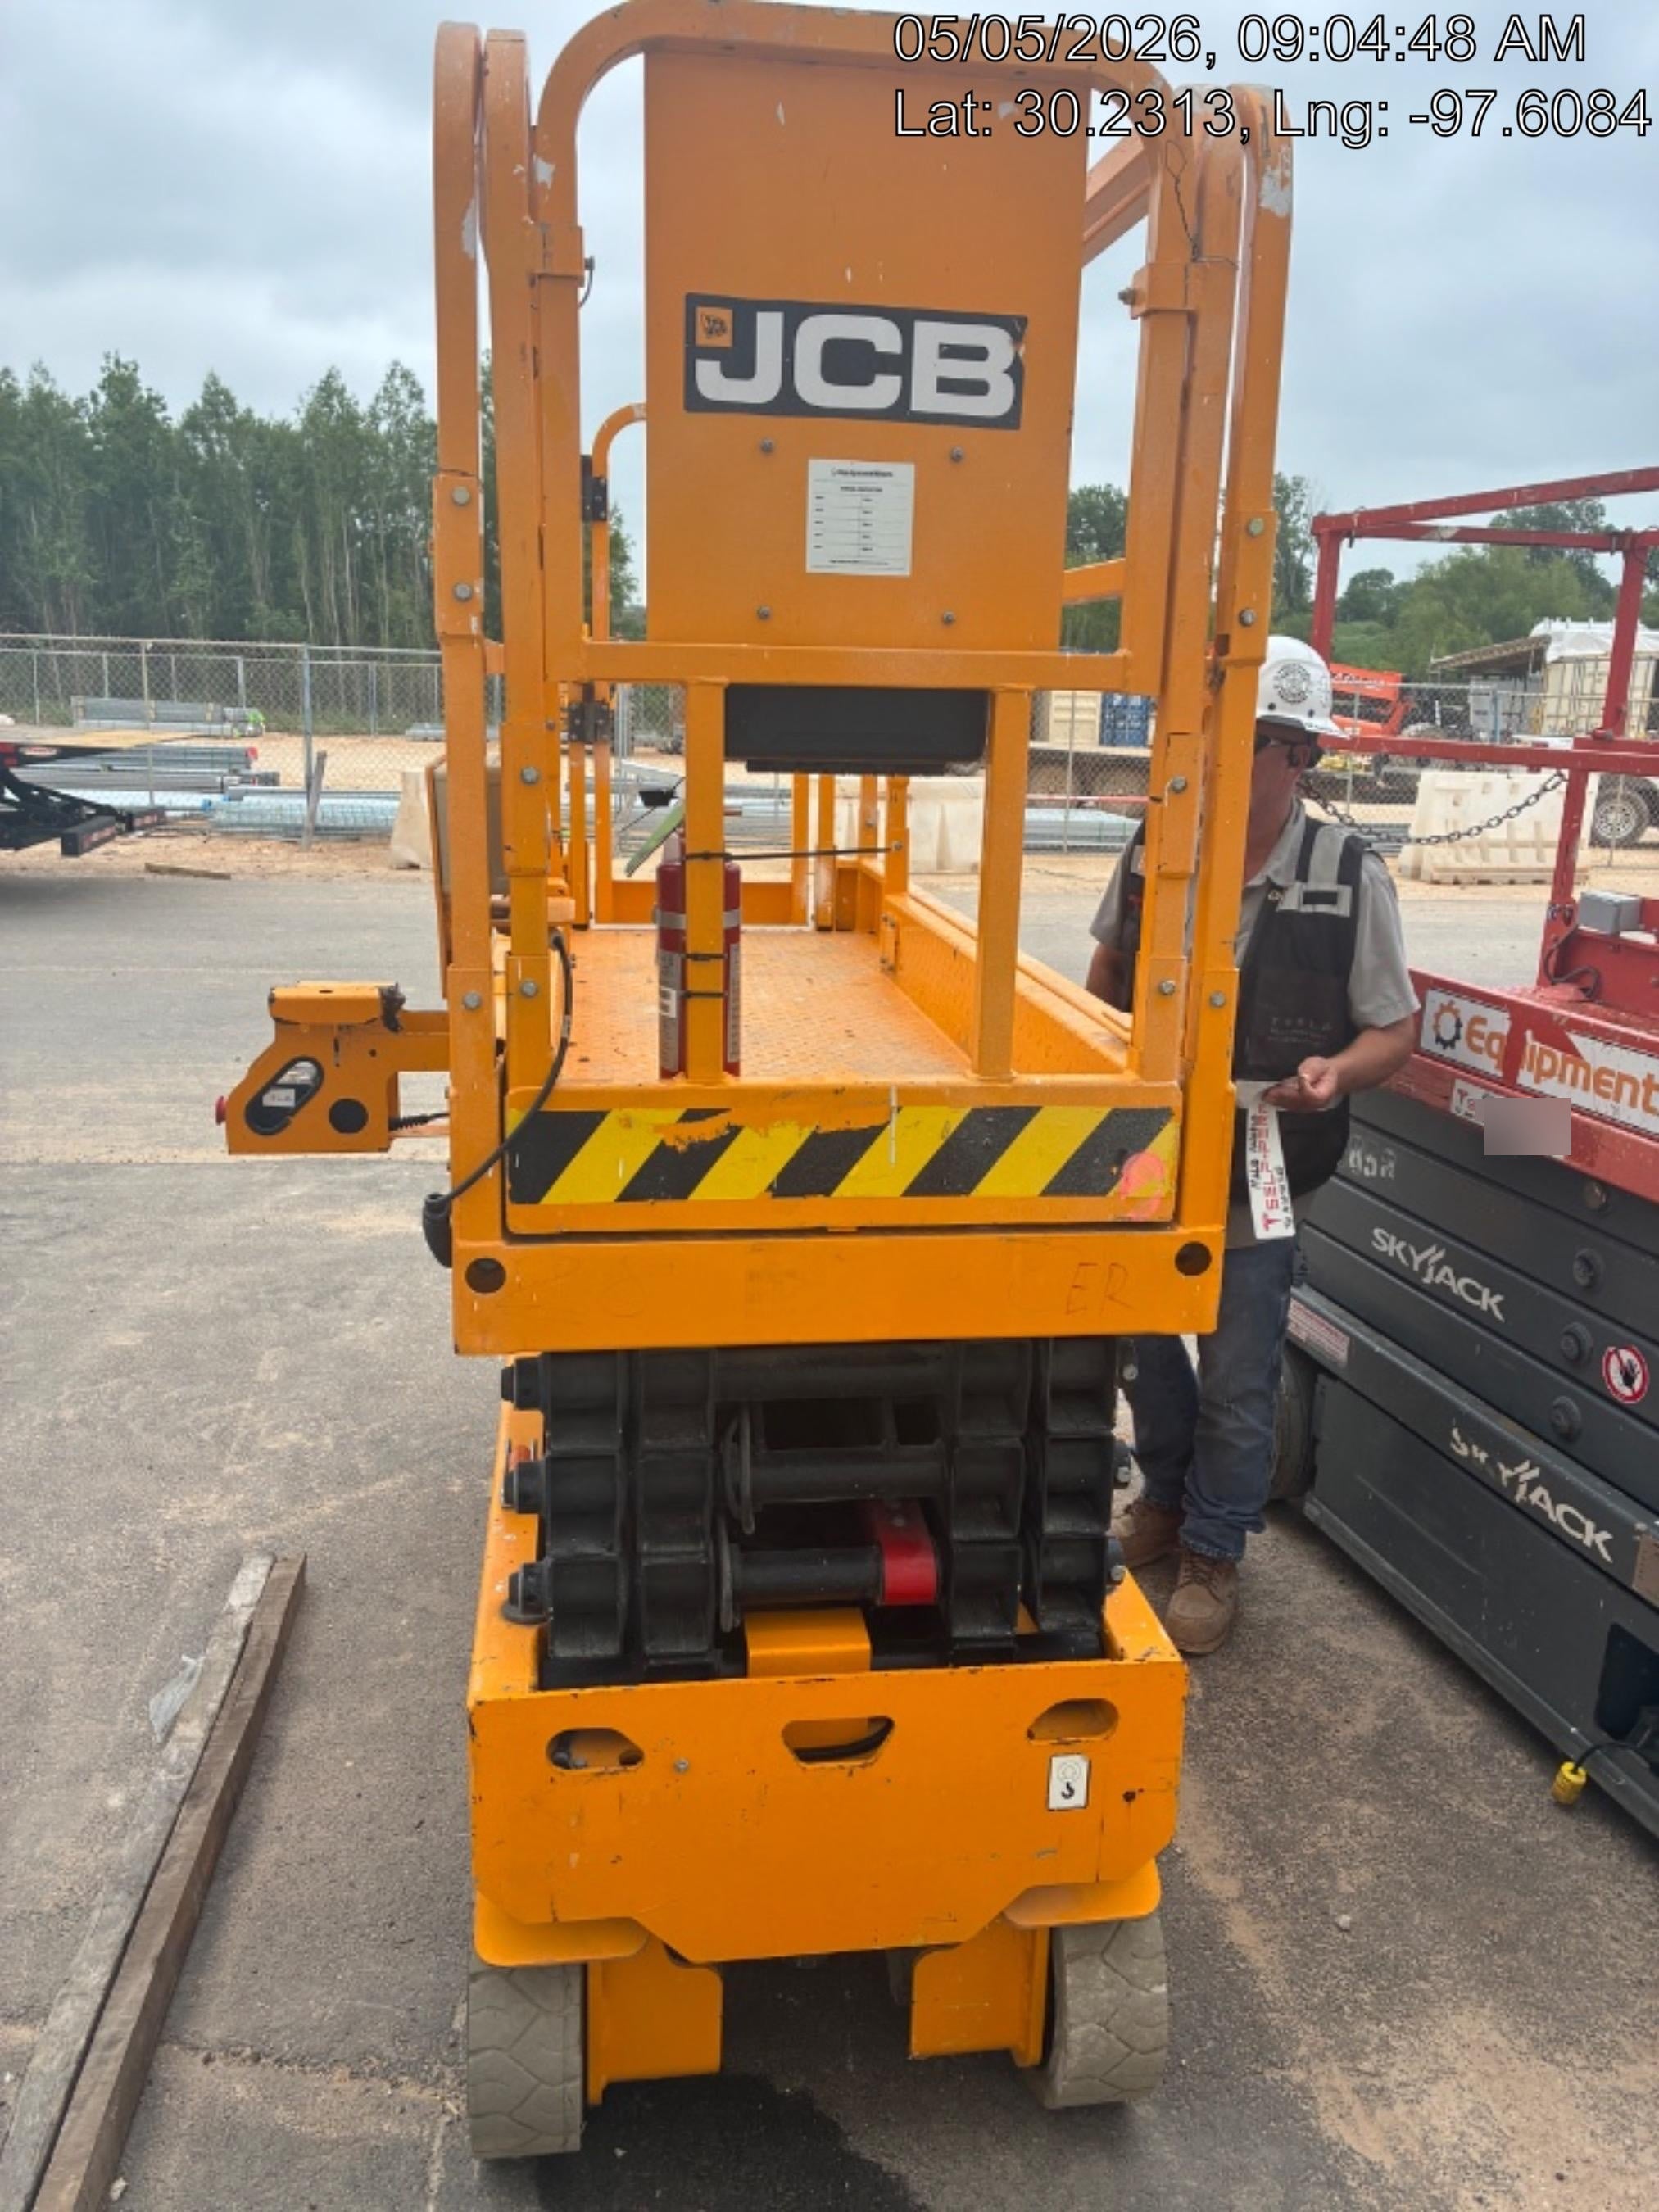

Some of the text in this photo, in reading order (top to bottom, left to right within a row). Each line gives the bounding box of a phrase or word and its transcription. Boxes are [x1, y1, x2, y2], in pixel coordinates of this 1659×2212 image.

[695, 310, 1016, 417] JCB
[1465, 1014, 1659, 1116] Eqipment
[1371, 1227, 1505, 1323] SKYJACK
